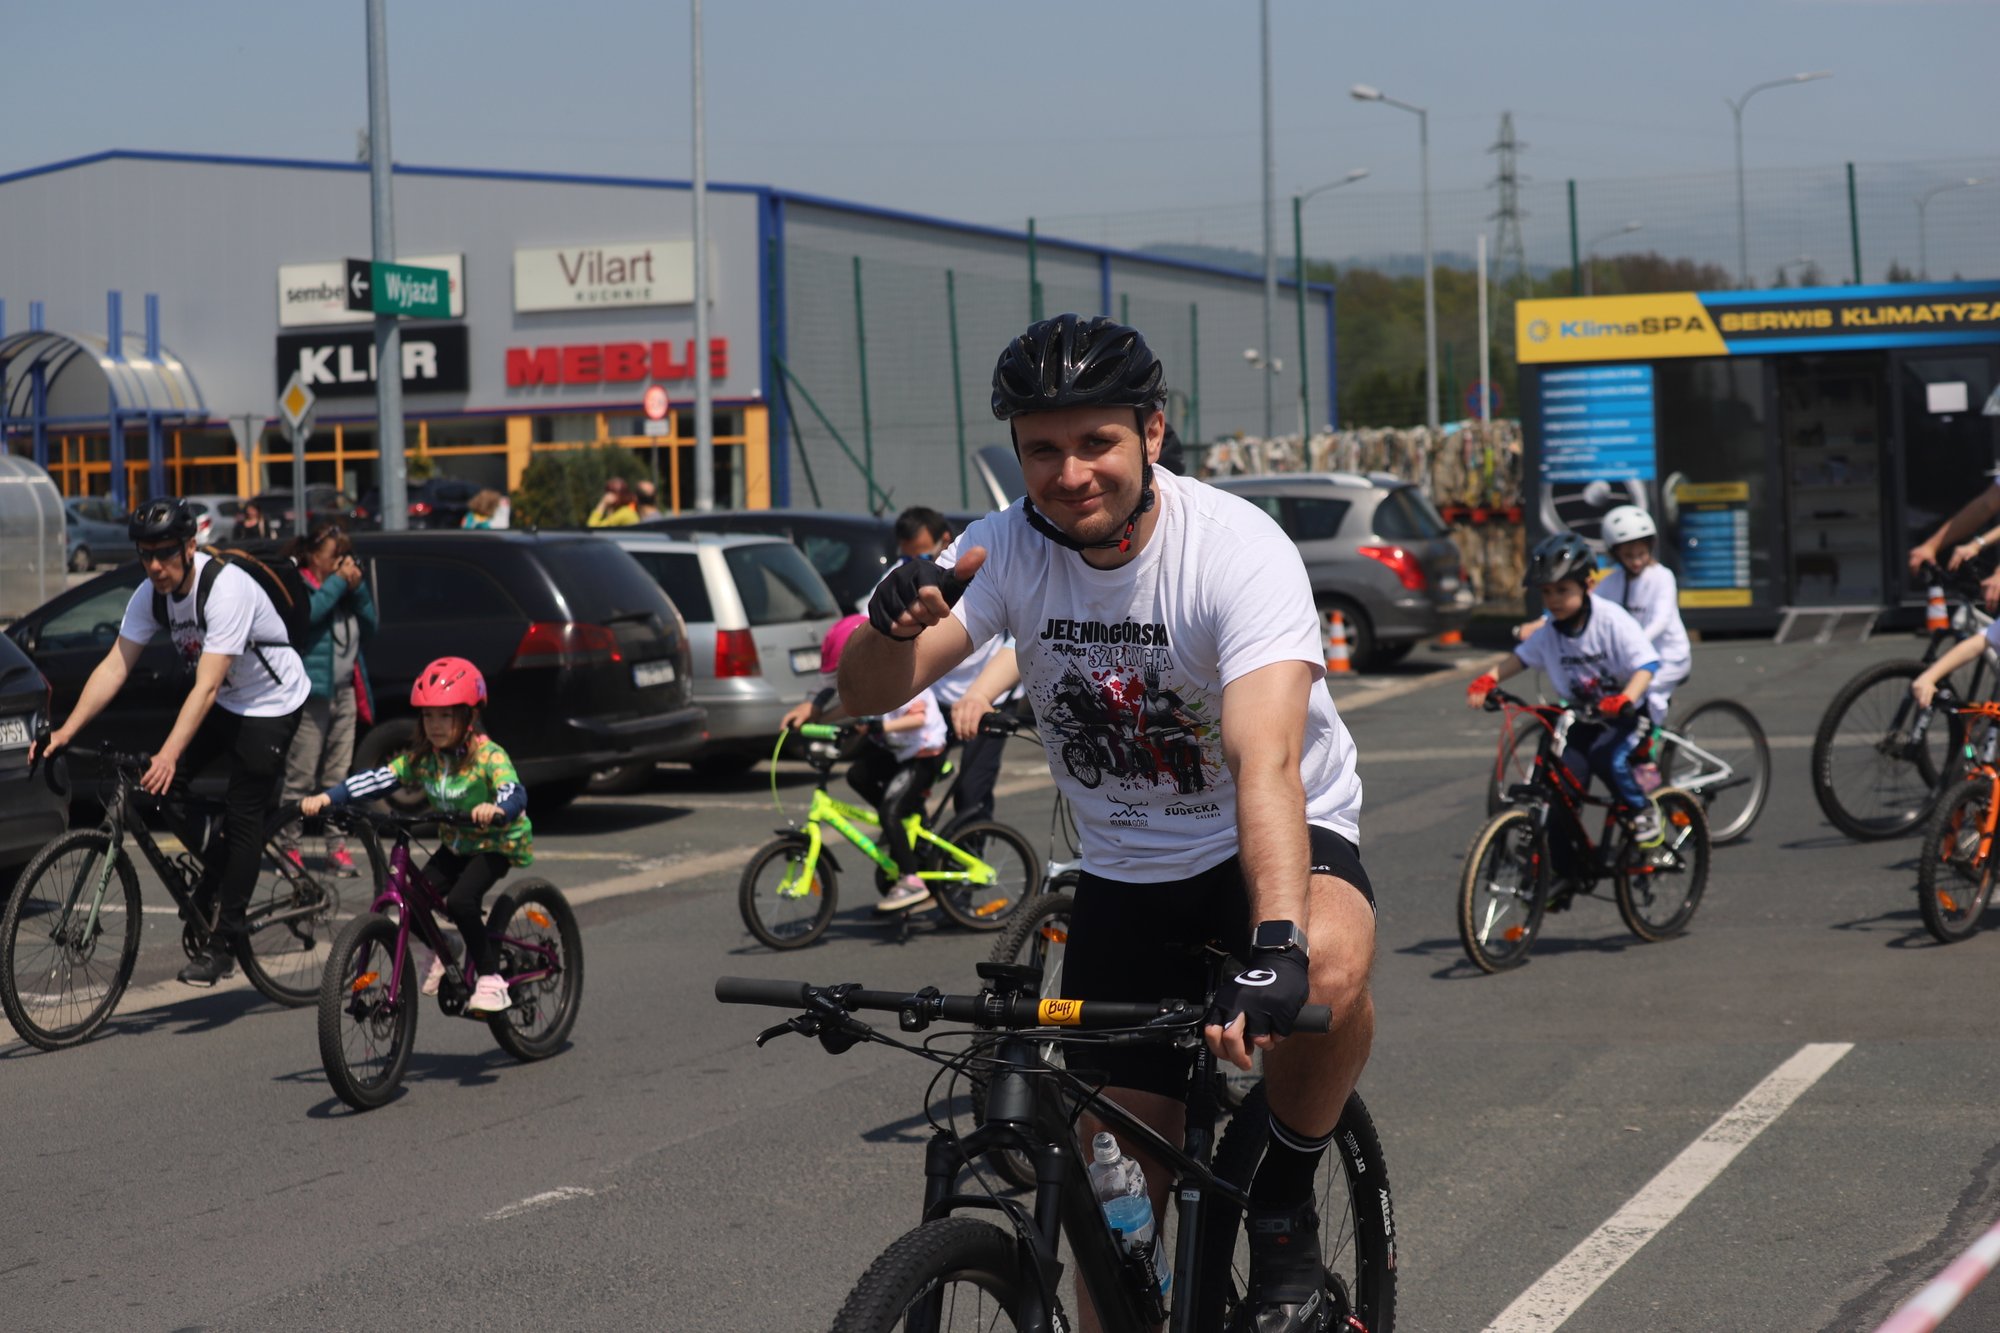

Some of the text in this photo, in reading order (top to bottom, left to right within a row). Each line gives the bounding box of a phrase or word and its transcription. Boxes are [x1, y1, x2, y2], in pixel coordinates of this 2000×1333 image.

[558, 251, 655, 286] Vilart
[384, 271, 438, 308] Wyjazd
[1560, 315, 1706, 338] KlimaSPA
[1720, 308, 1833, 332] SERWIS
[299, 340, 438, 385] KLR
[506, 337, 728, 388] MEBLE
[1165, 803, 1220, 816] SUDECKA
[1048, 1000, 1072, 1016] Buff
